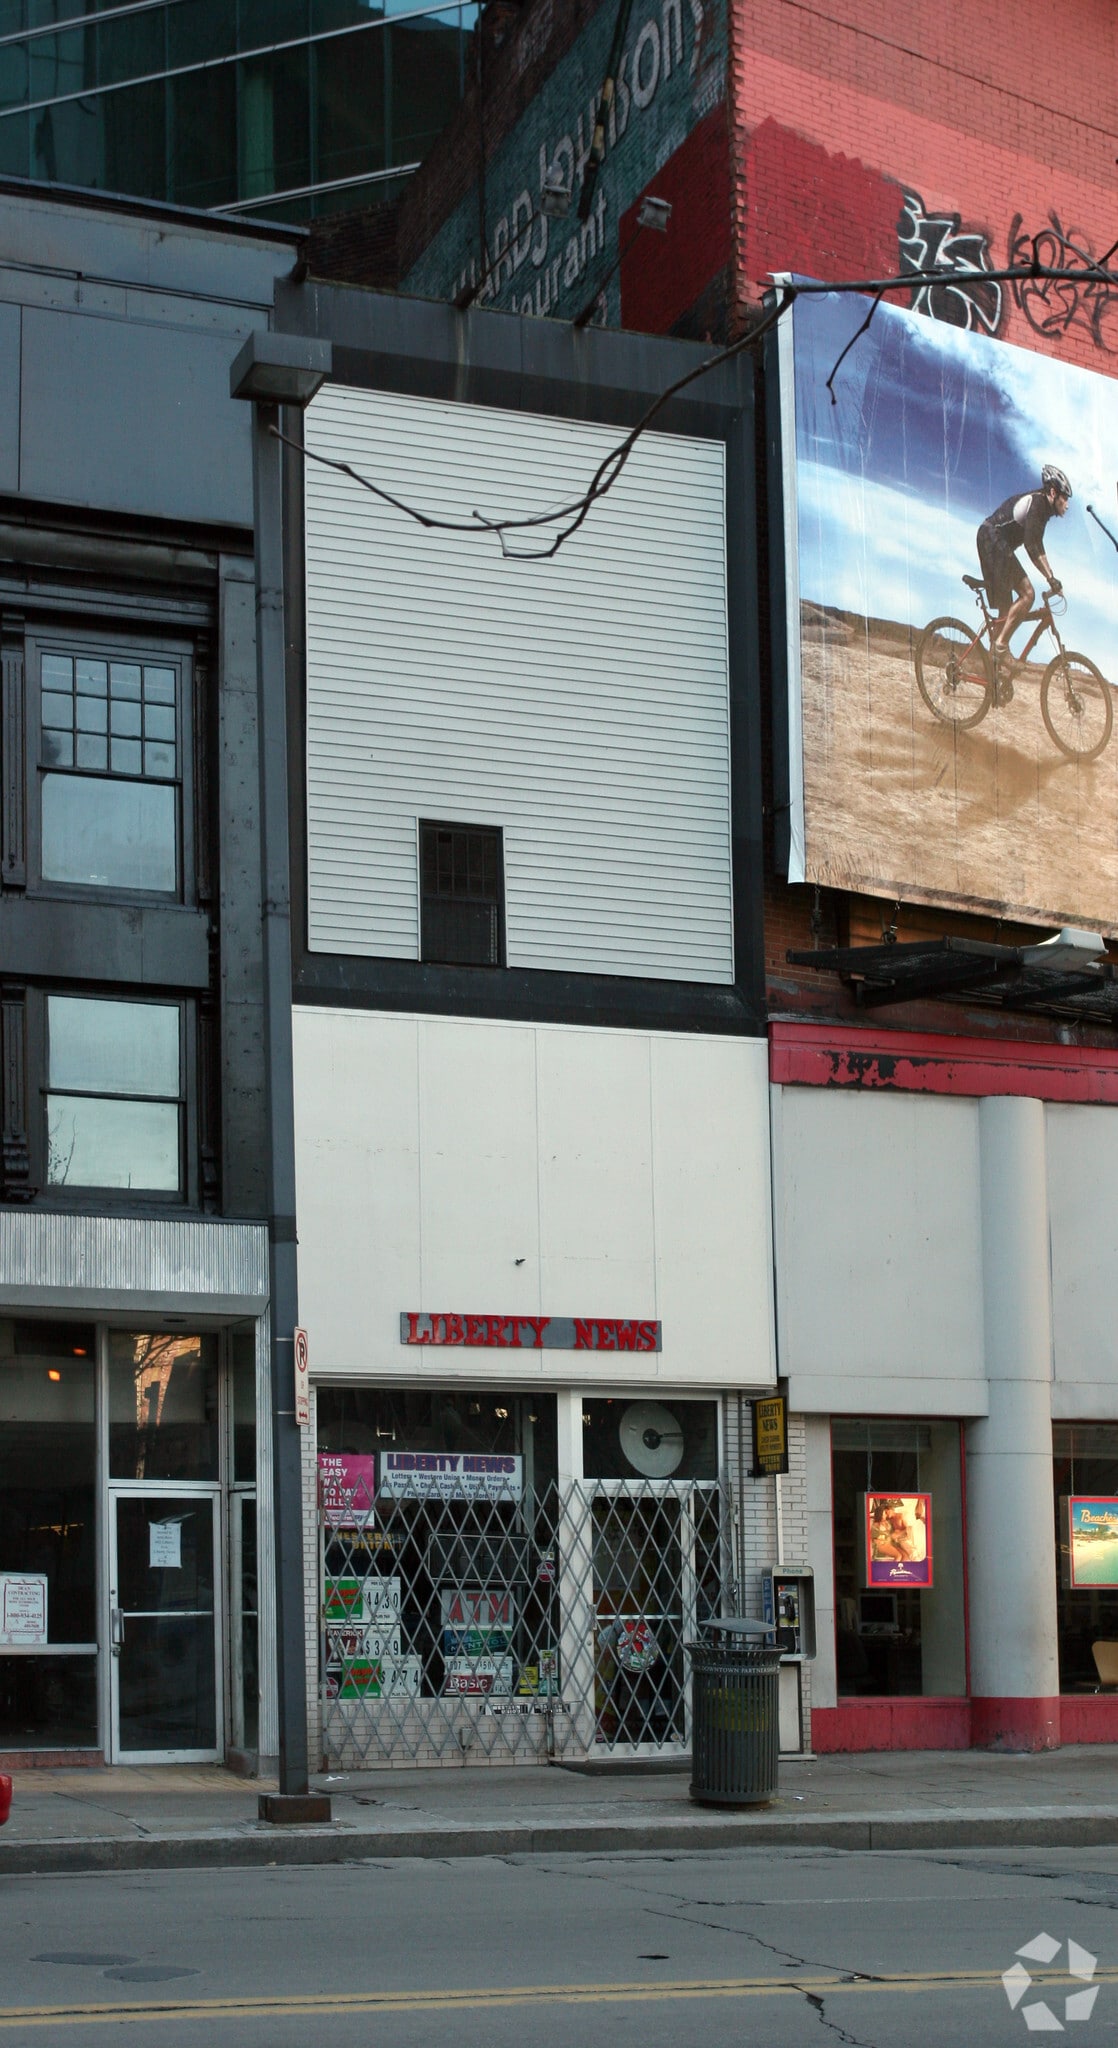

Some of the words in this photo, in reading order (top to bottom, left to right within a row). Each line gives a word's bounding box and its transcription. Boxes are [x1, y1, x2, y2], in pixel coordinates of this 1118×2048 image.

[407, 1312, 551, 1347] LIBERTY
[573, 1318, 657, 1351] NEWS
[759, 1403, 781, 1417] LIBERTY
[763, 1418, 778, 1431] NEWS
[322, 1458, 343, 1467] THE
[387, 1454, 460, 1472] LIBERTY
[463, 1456, 516, 1473] NEWS
[335, 1531, 393, 1541] WESERN
[448, 1593, 510, 1623] ATM
[450, 1678, 488, 1689] Basic
